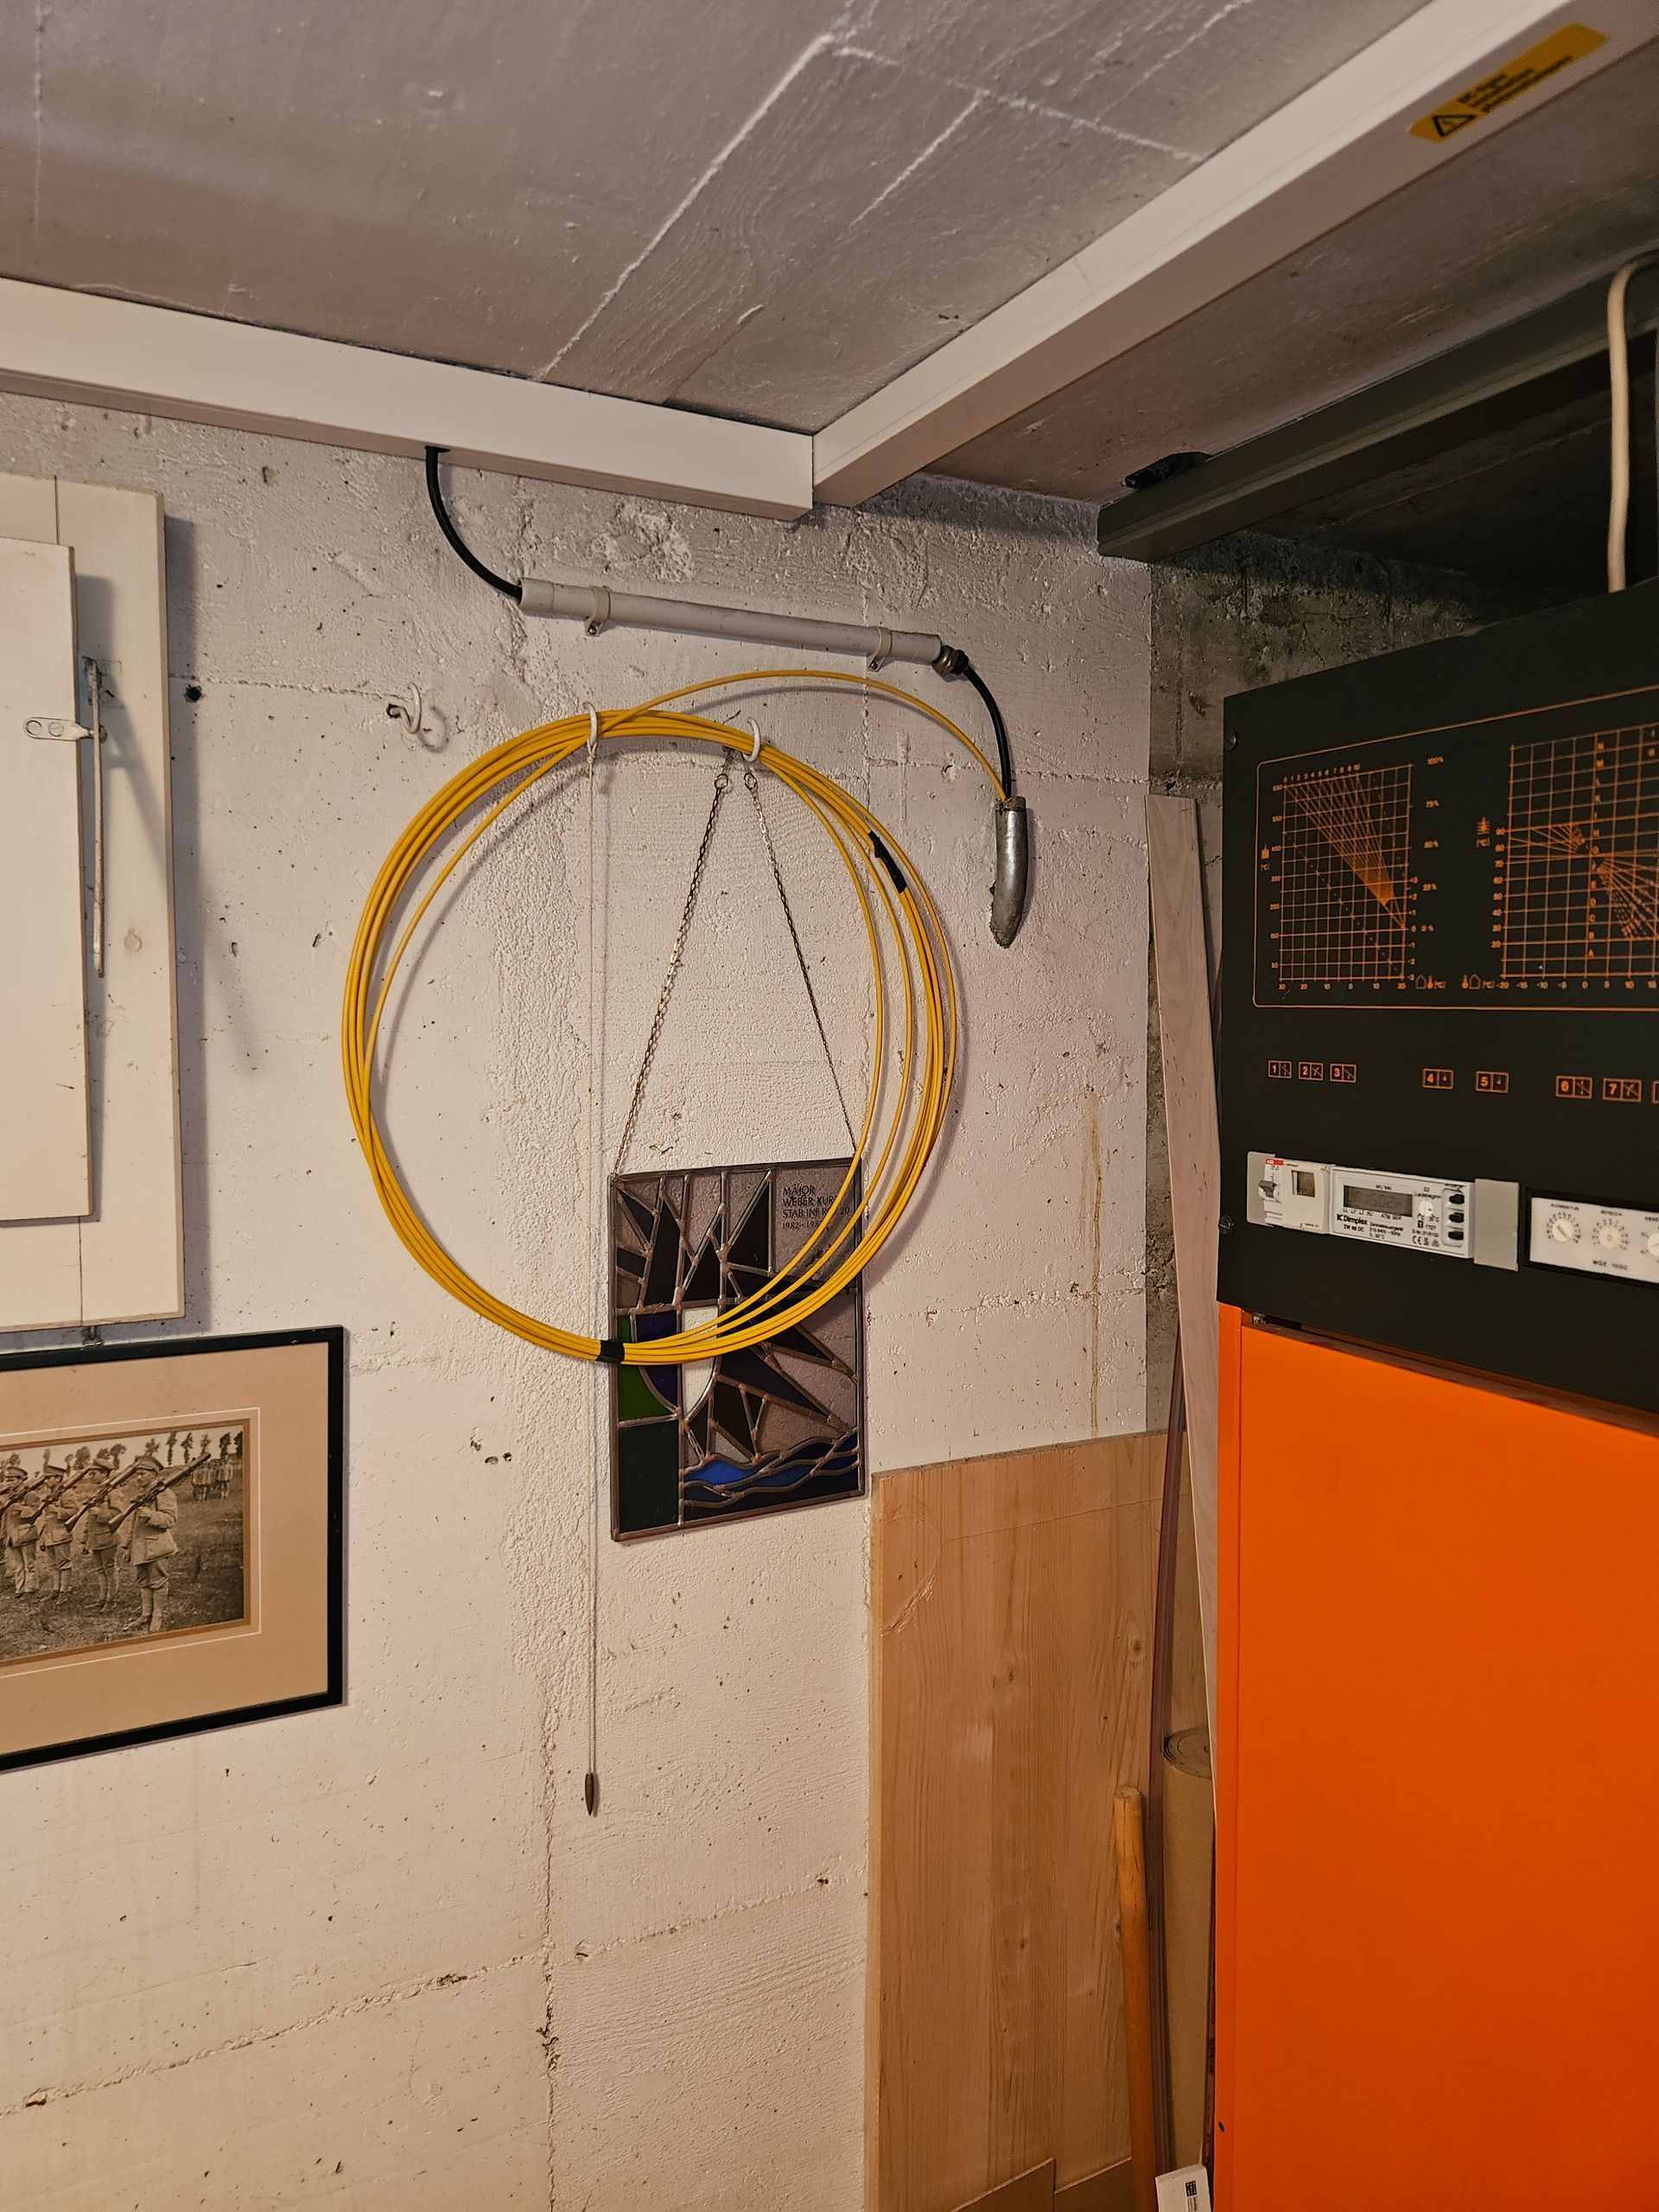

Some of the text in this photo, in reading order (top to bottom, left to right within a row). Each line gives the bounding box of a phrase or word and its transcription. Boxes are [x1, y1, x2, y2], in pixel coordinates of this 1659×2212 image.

[1272, 1065, 1277, 1074] 1
[1302, 1065, 1309, 1076] 2
[1333, 1067, 1341, 1077] 3
[1426, 1072, 1435, 1084] 4
[1479, 1076, 1489, 1087] 5
[1560, 1080, 1569, 1093] 6
[1608, 1083, 1618, 1096] 7
[783, 1185, 816, 1196] MAJOR
[783, 1195, 838, 1206] WEBER KUR
[840, 1206, 850, 1215] 20
[782, 1221, 799, 1230] 1982
[1344, 1215, 1368, 1225] Dimplex
